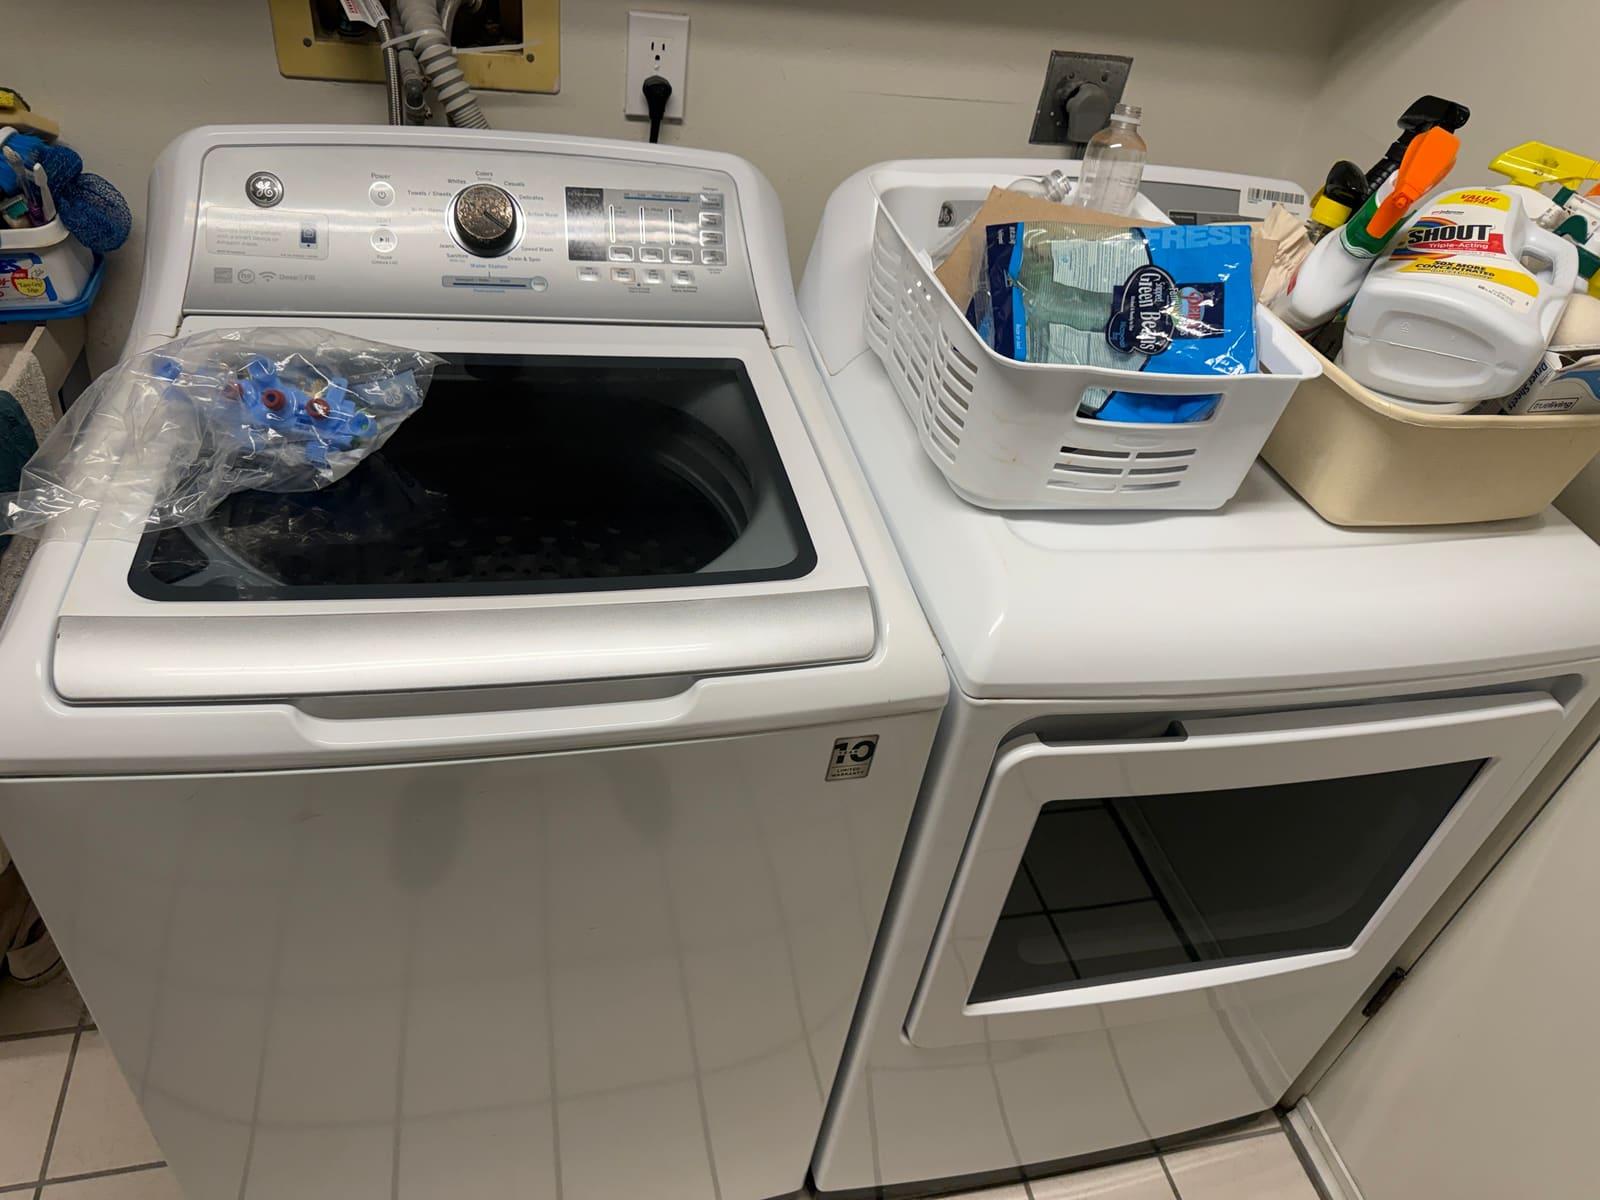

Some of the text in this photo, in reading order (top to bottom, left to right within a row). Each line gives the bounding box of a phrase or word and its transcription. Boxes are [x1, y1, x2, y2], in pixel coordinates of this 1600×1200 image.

[1461, 194, 1499, 203] VALUE
[1144, 226, 1249, 249] FRESH
[1408, 224, 1492, 244] SHOUT
[1429, 241, 1489, 249] Triple-Acting
[1415, 263, 1495, 277] CONCENTRATED
[1456, 263, 1487, 272] MORE
[1138, 273, 1161, 308] Green
[1508, 362, 1548, 411] Dryer Sheets
[833, 740, 876, 764] 10
